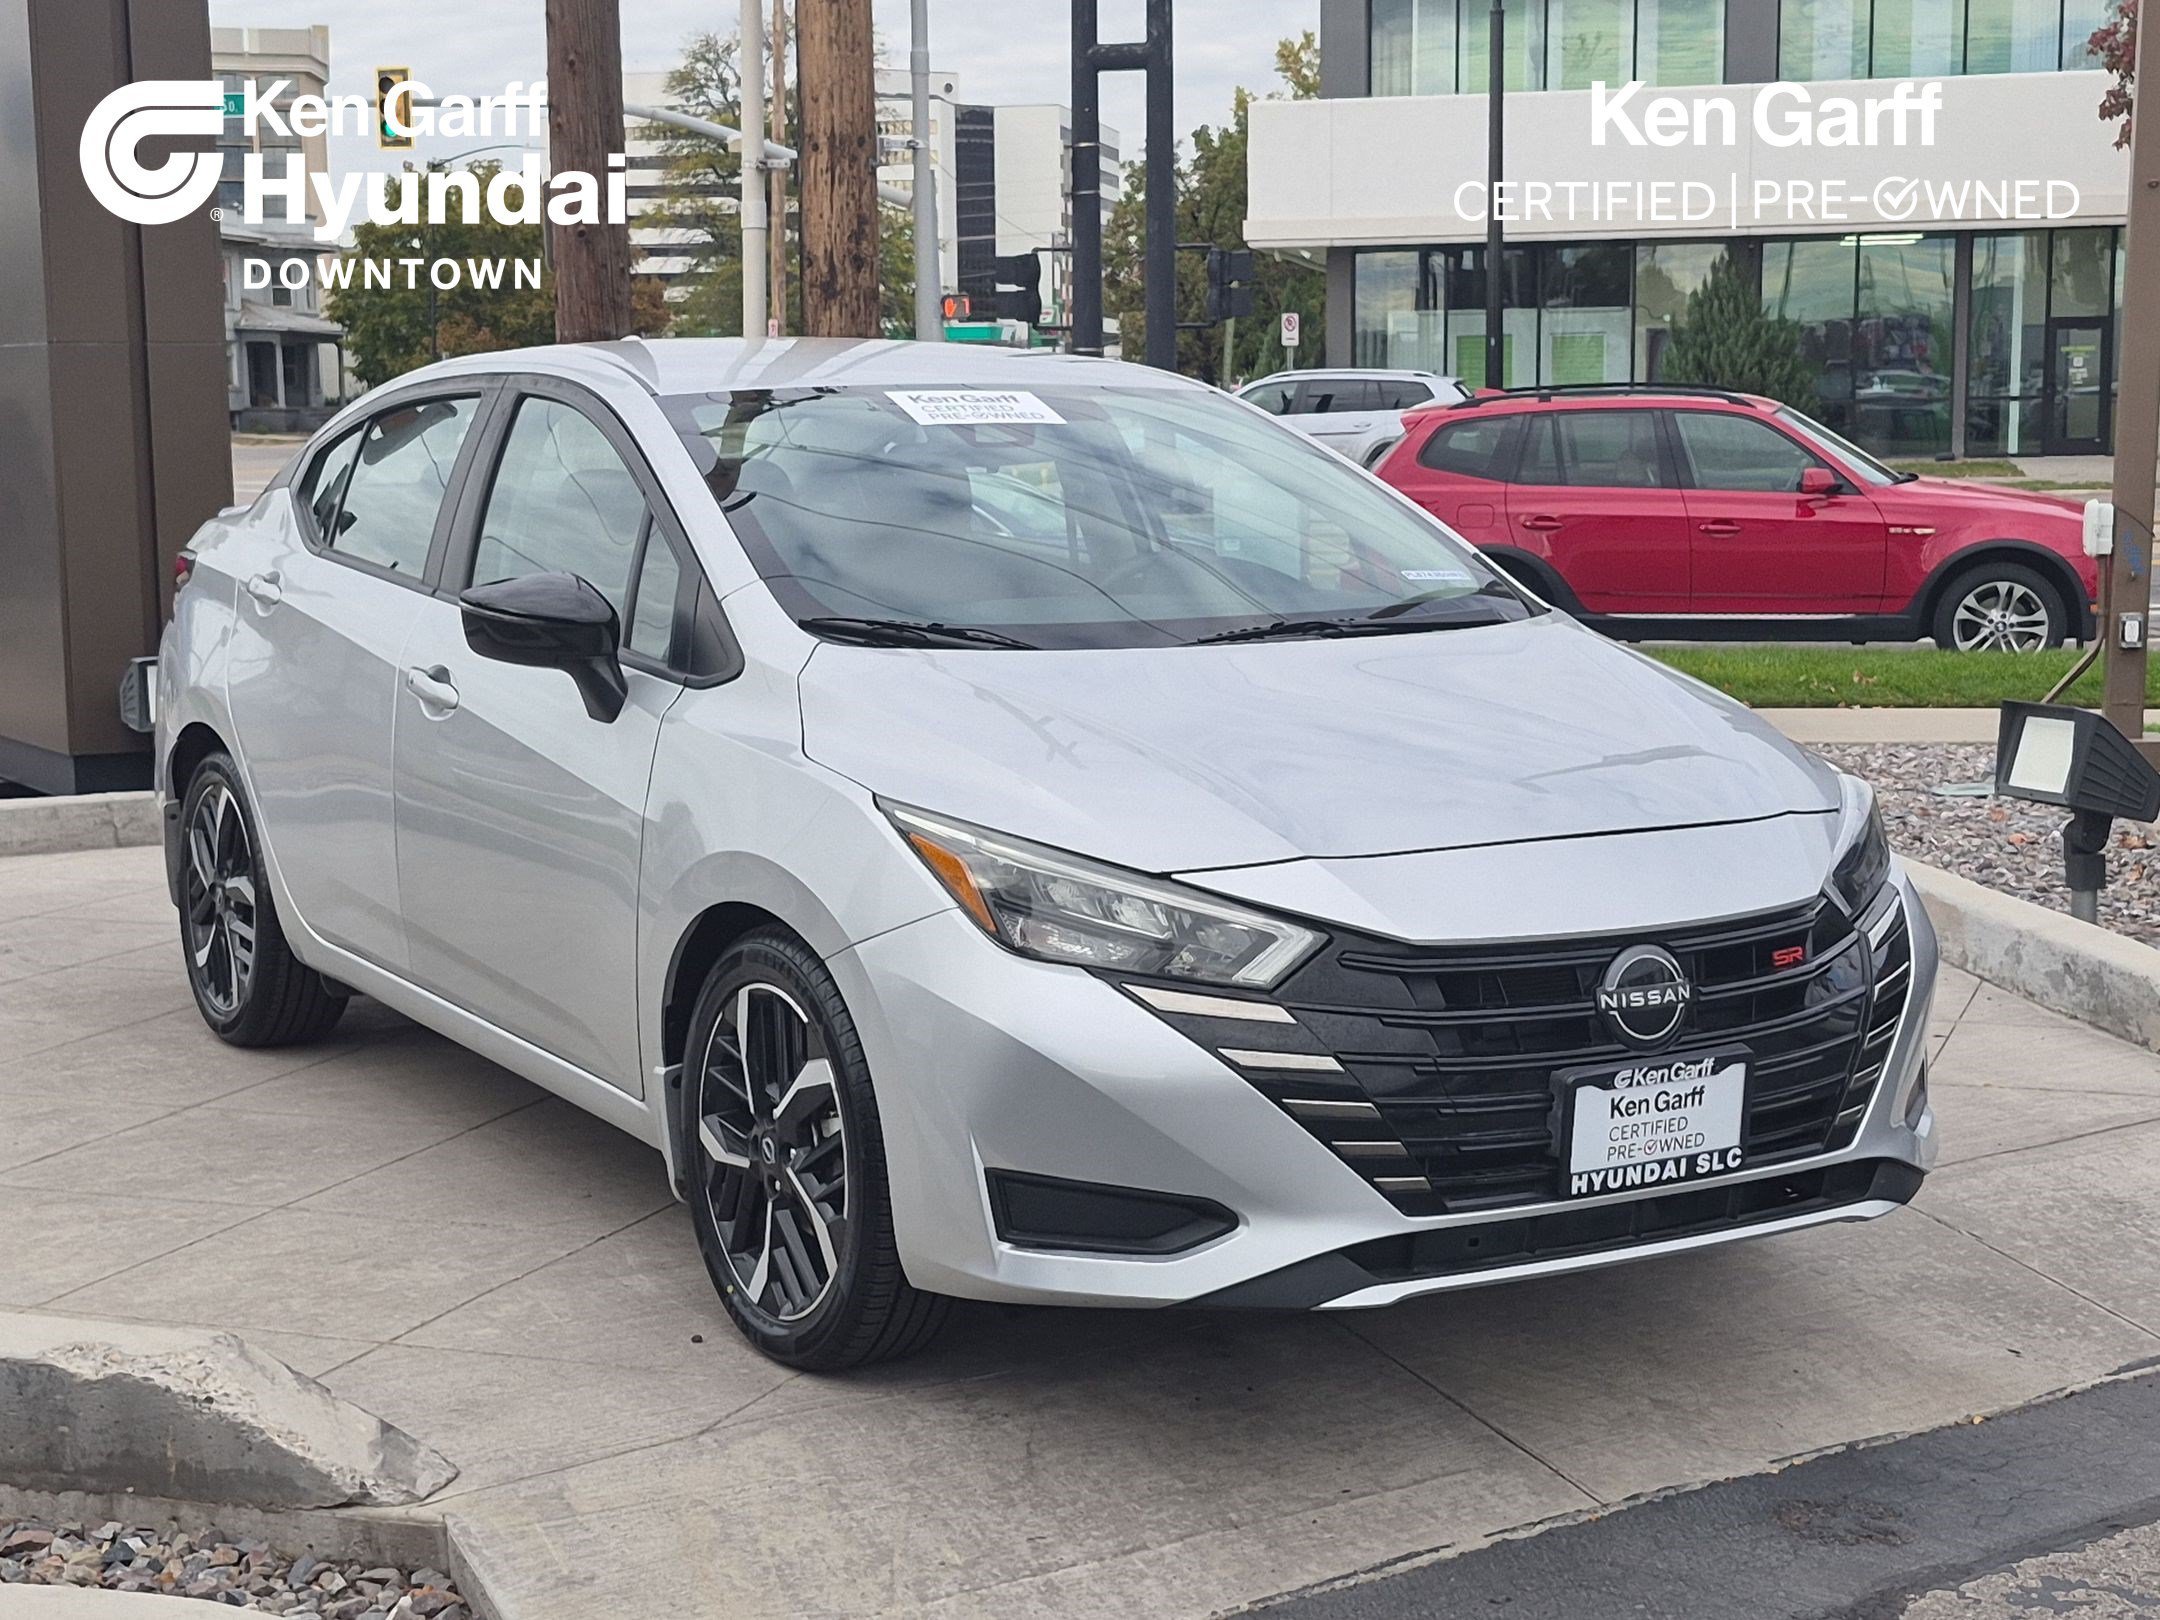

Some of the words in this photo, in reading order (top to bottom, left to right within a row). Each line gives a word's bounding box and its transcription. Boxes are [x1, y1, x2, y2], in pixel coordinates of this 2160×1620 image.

[907, 394, 959, 404] Ken
[960, 393, 1021, 404] Garff
[921, 404, 1015, 413] CERTIFIED
[1772, 946, 1804, 967] SR
[1600, 983, 1690, 1010] NISSAN
[1632, 1066, 1668, 1088] Ken
[1670, 1057, 1716, 1082] Garff
[1610, 1095, 1650, 1119] Ken
[1653, 1084, 1706, 1113] Garff
[1609, 1116, 1689, 1142] CERTIFIED
[1570, 1157, 1687, 1196] HYUNDAI
[1695, 1146, 1743, 1174] SLC
